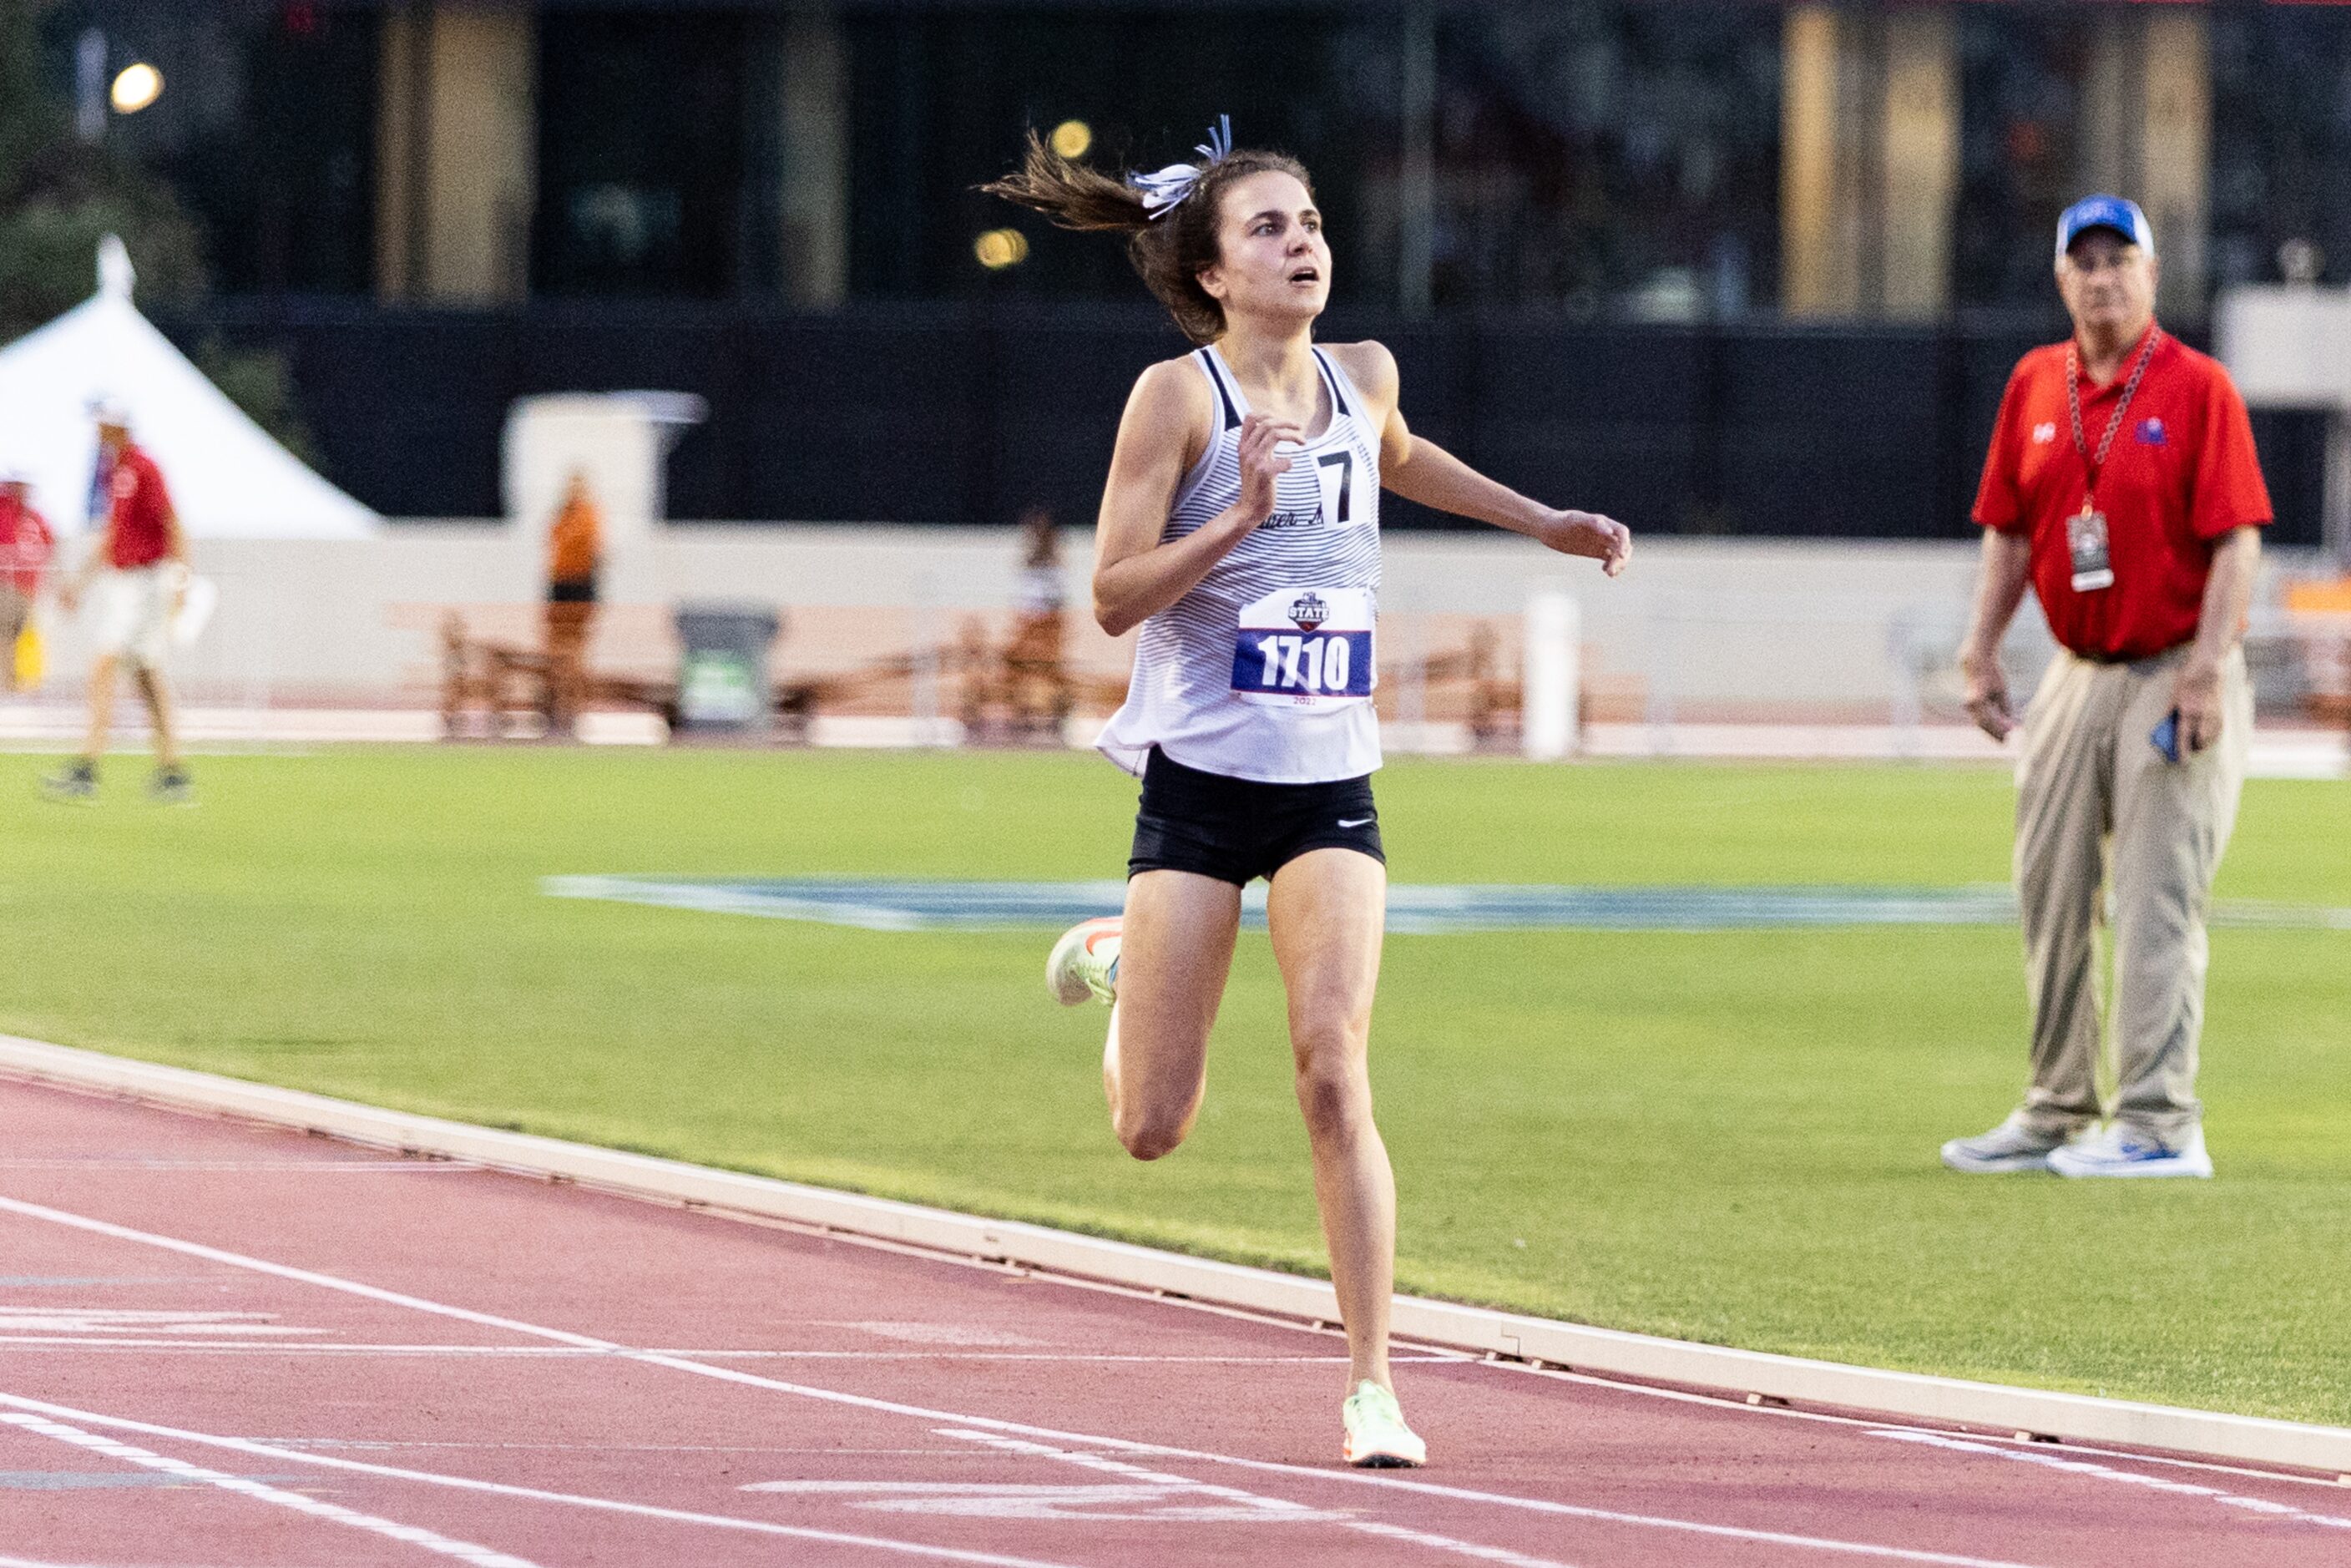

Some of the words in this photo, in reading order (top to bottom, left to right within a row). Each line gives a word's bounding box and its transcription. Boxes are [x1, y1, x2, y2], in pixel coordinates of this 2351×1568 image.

[1317, 450, 1352, 524] 7
[1288, 606, 1330, 620] STATE
[1257, 635, 1350, 691] 1710
